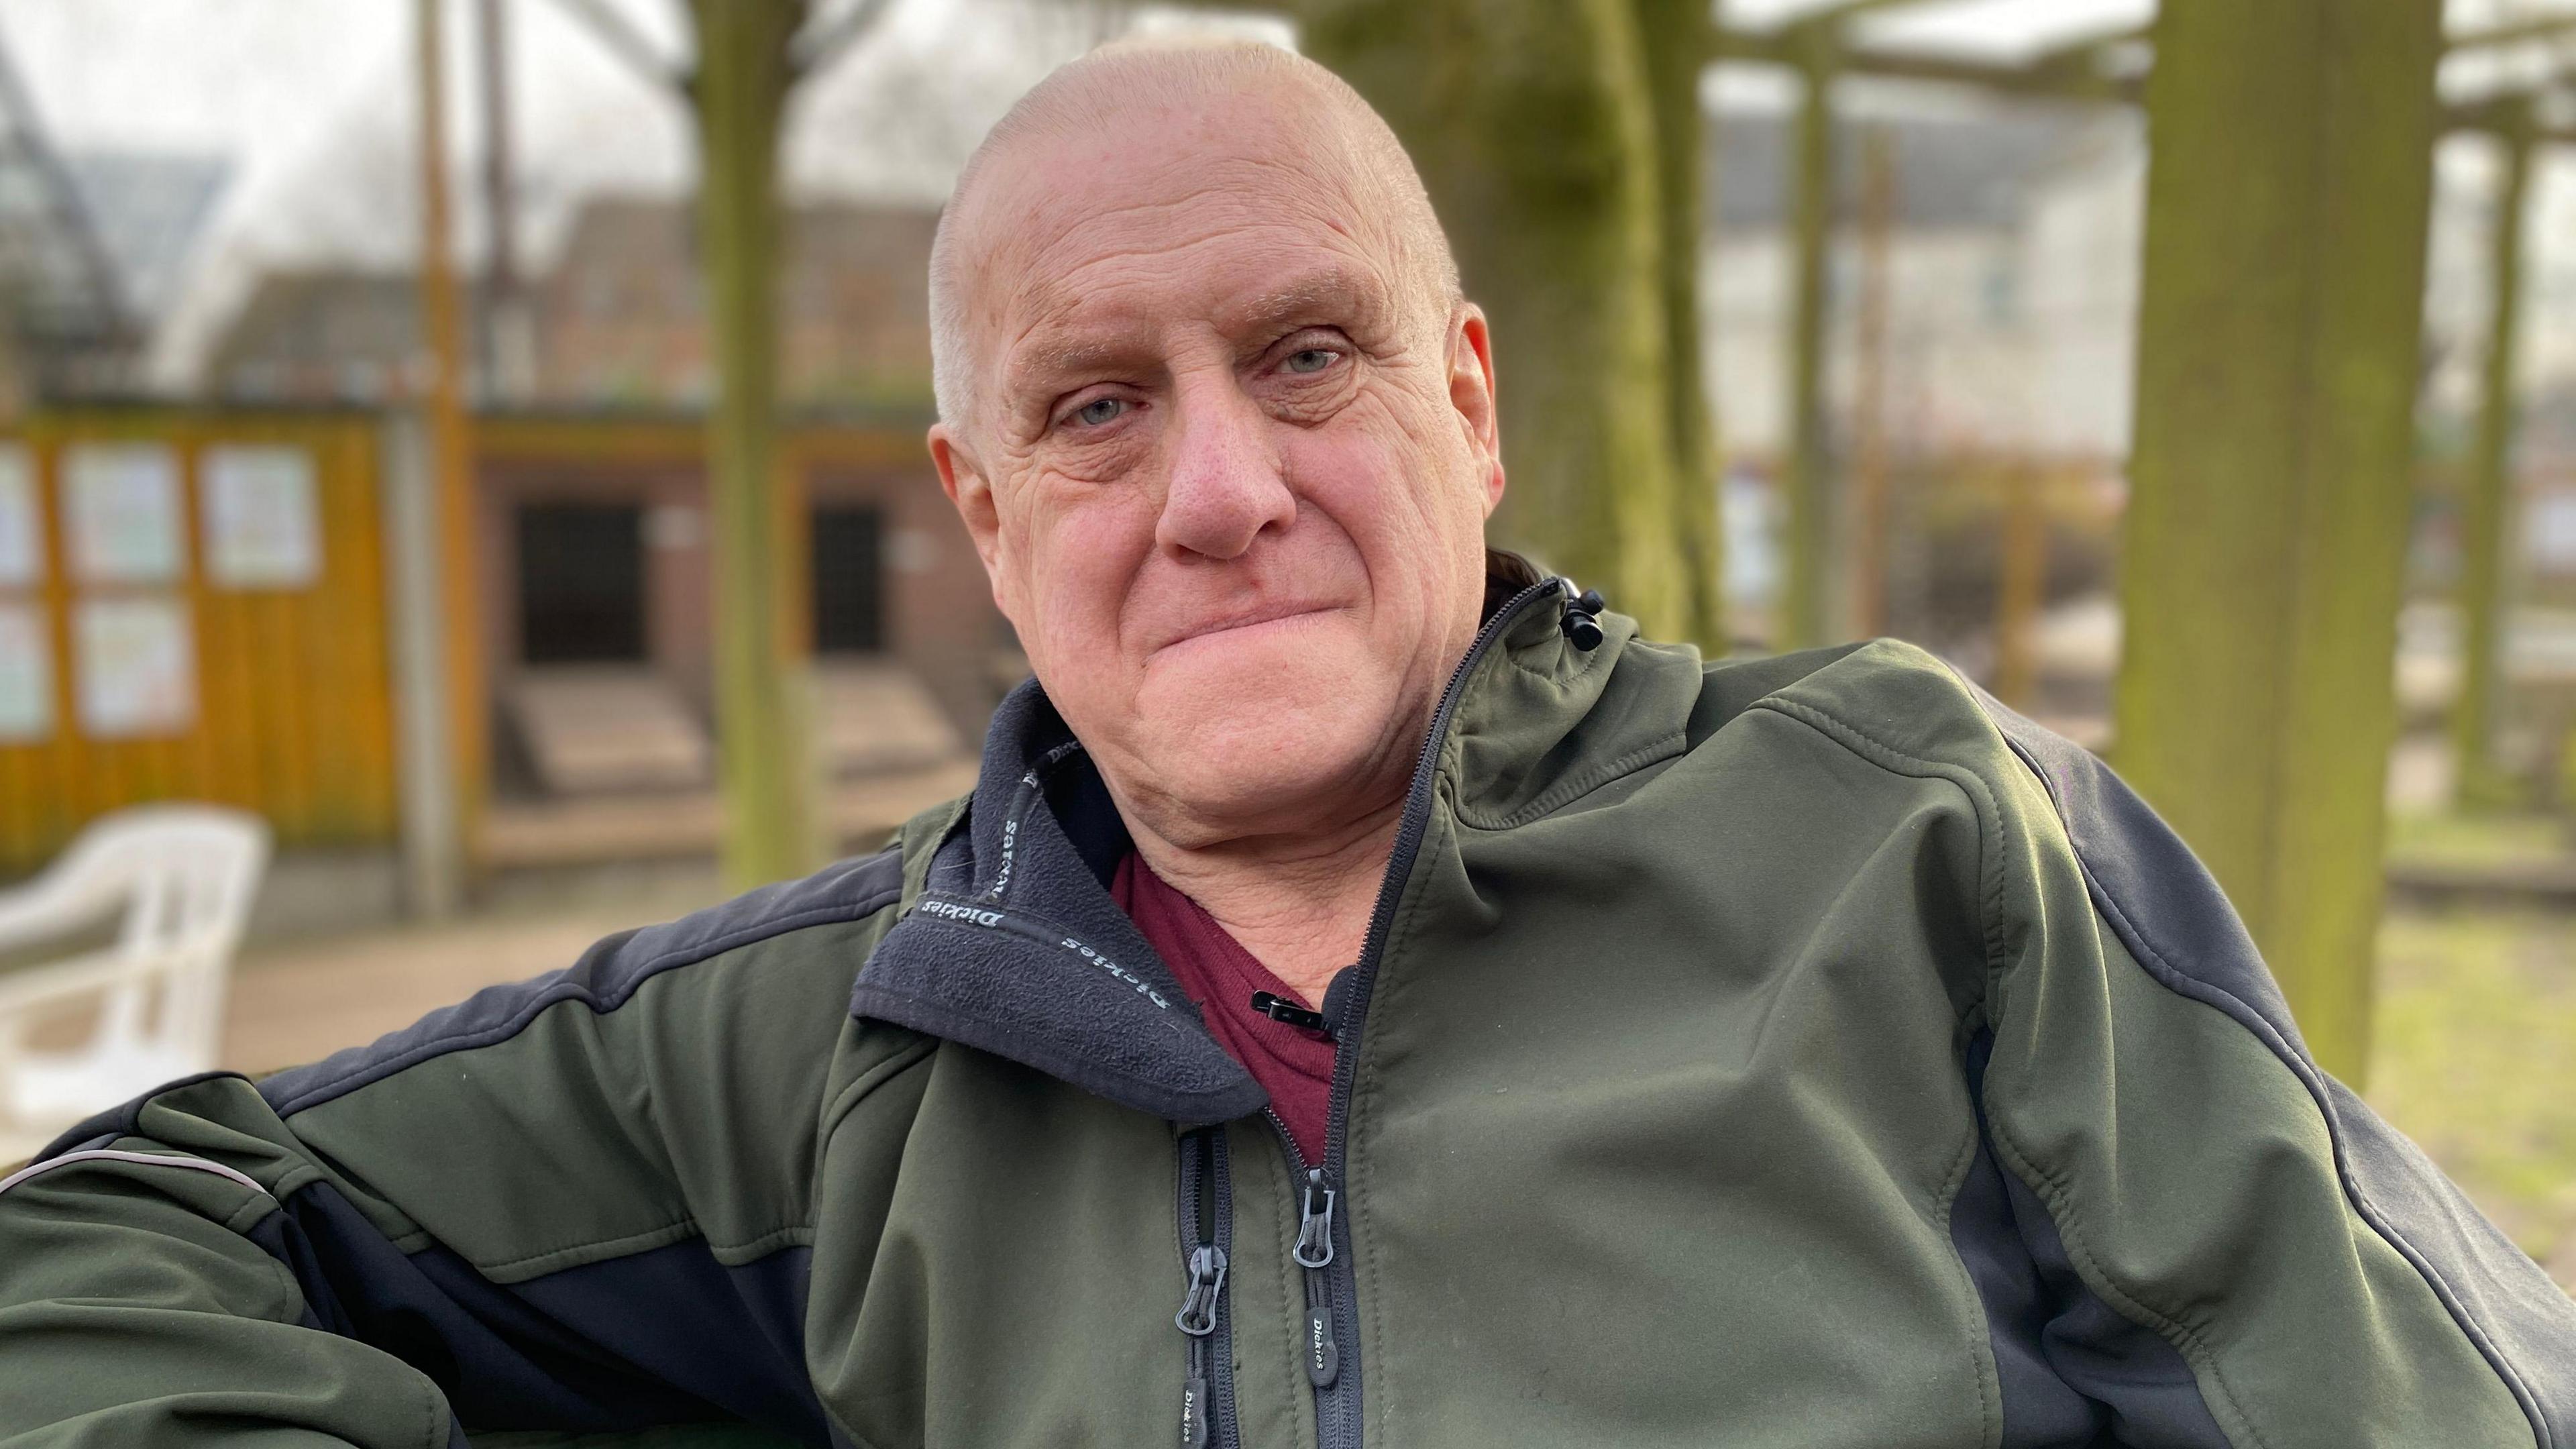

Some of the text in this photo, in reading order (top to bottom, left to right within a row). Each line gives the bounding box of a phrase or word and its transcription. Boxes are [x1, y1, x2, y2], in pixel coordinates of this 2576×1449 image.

[922, 901, 1005, 927] Dickies
[1061, 937, 1171, 1009] Dickies
[1313, 1318, 1324, 1370] Dickies
[1183, 1389, 1193, 1442] Dickies
